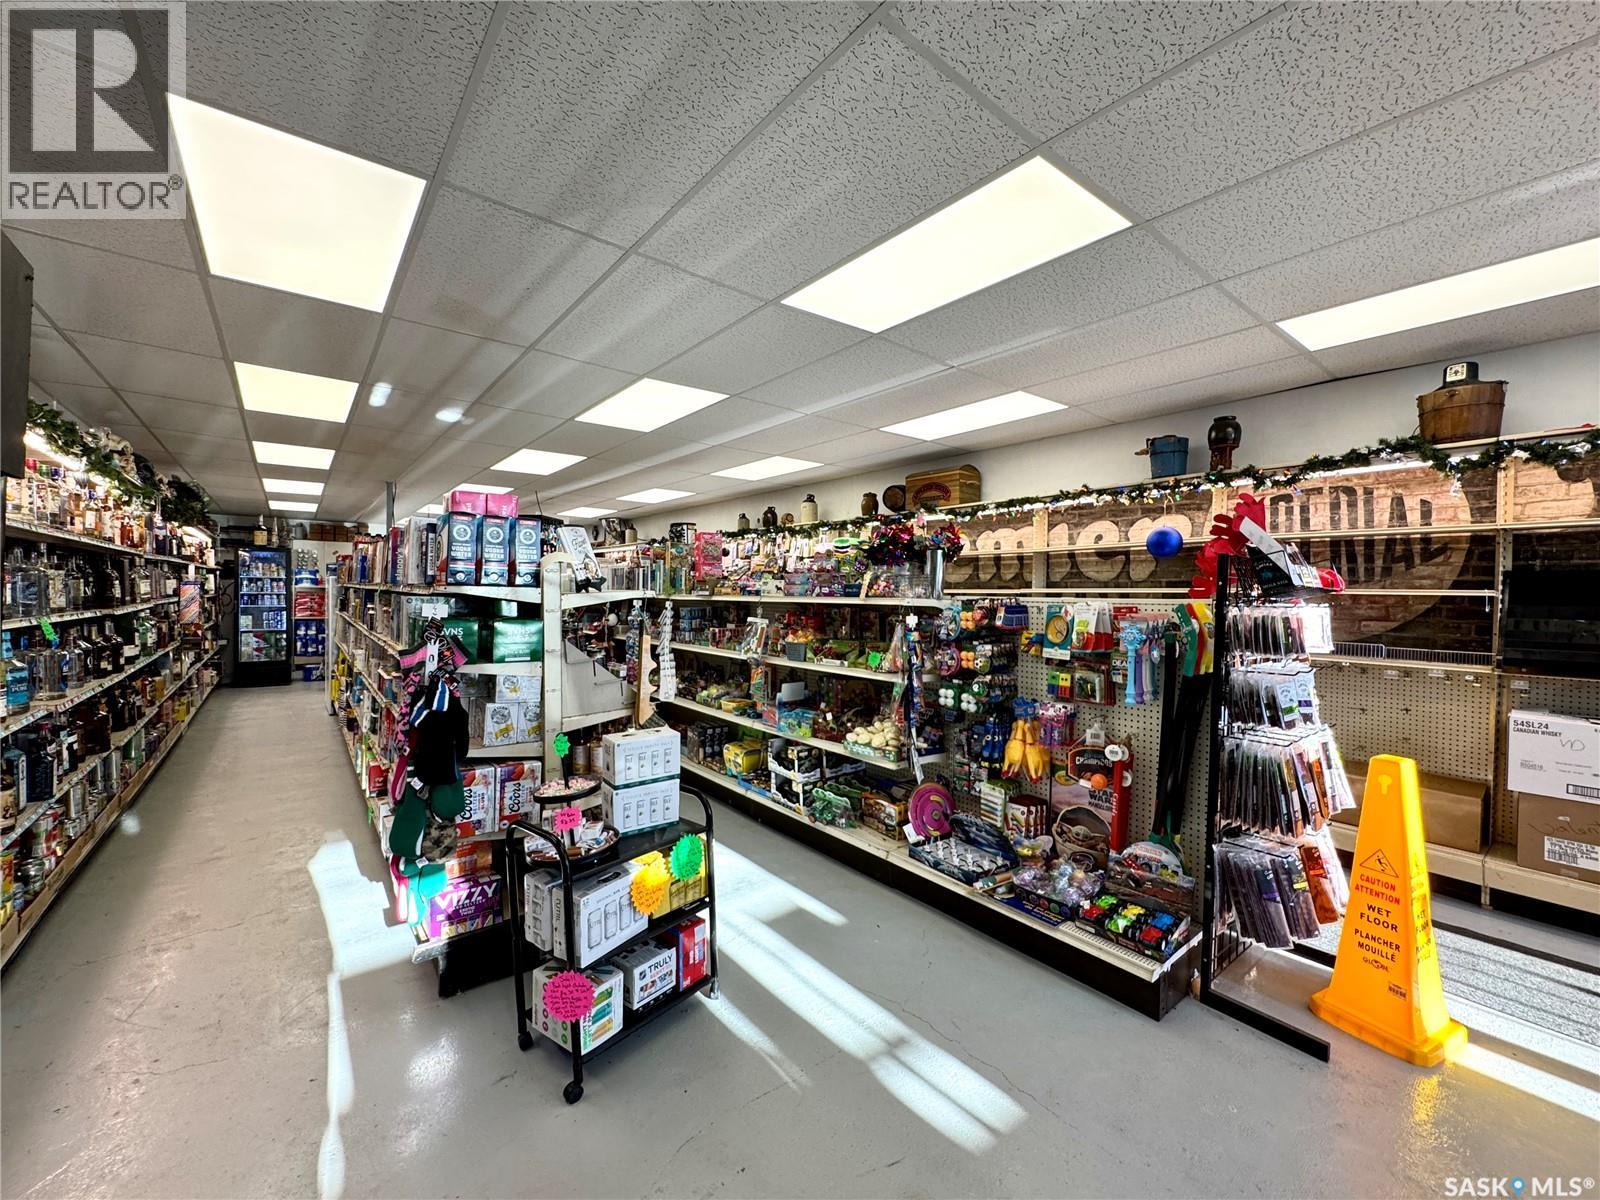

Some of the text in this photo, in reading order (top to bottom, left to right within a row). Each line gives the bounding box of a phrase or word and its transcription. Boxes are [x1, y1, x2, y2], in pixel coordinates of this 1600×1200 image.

[1512, 719, 1550, 730] 54SL24
[1512, 727, 1563, 738] CANADIAN WHISKY
[460, 788, 473, 822] Coors
[508, 782, 522, 814] Coors
[1360, 873, 1396, 892] CAUTION
[434, 882, 497, 910] VIZZY
[1355, 884, 1400, 905] ATTENTION
[1366, 903, 1392, 918] WET
[1360, 912, 1398, 932] FLOOR
[1354, 928, 1401, 952] PLANCHER
[1357, 941, 1396, 963] MOUILLÉ
[648, 953, 673, 973] TRULY
